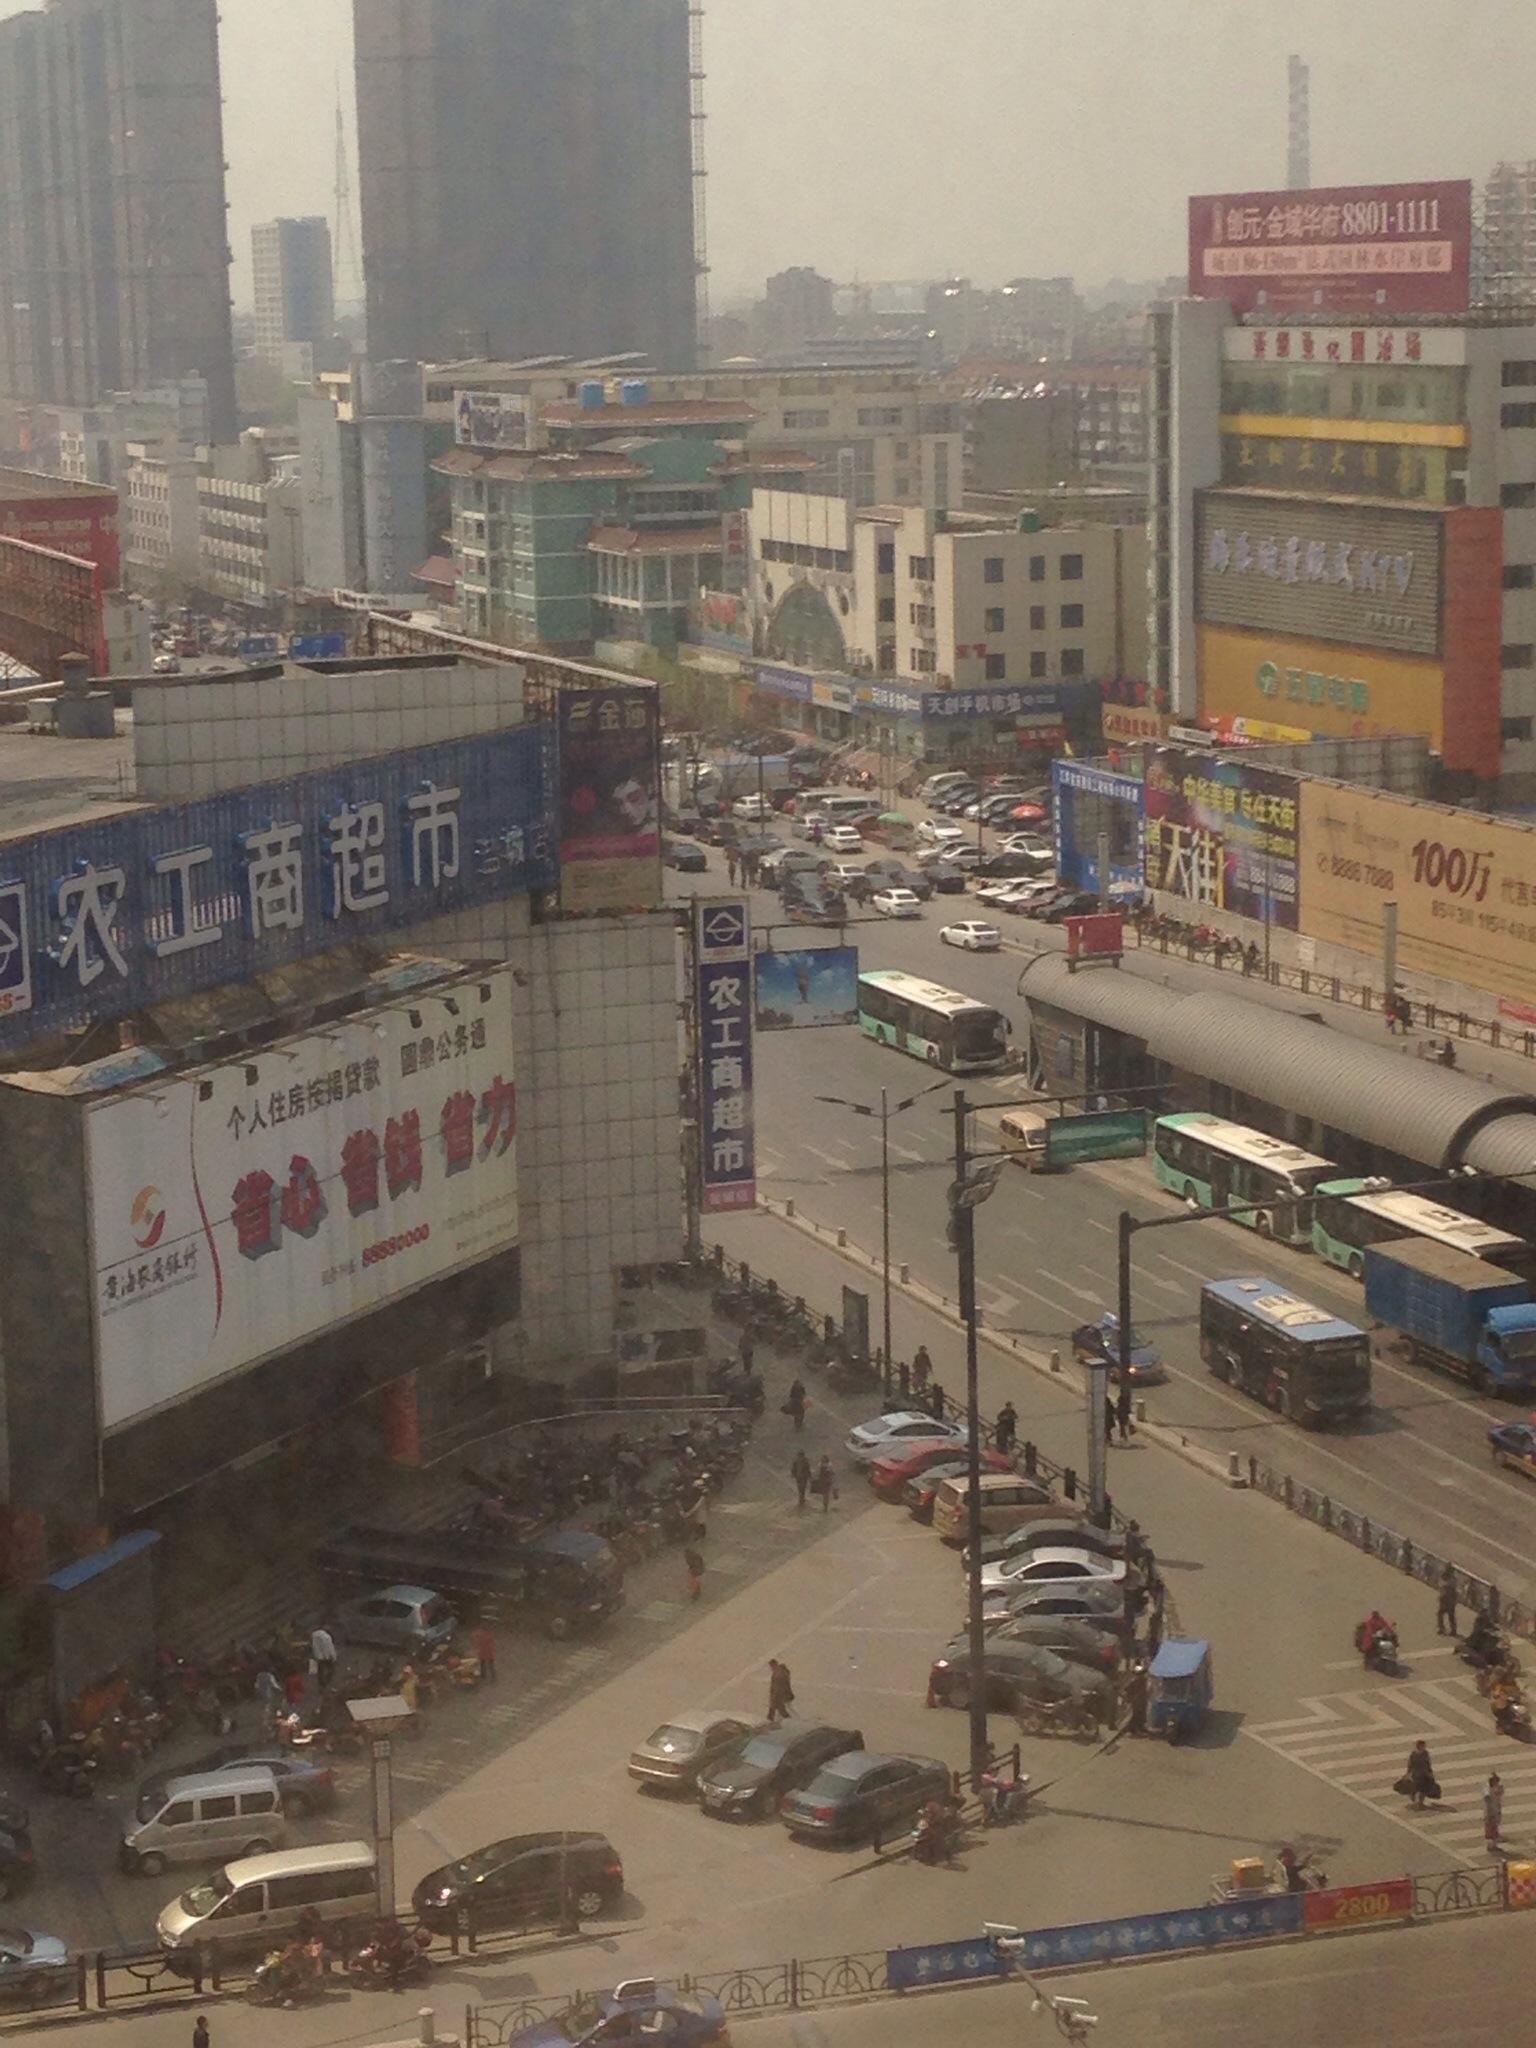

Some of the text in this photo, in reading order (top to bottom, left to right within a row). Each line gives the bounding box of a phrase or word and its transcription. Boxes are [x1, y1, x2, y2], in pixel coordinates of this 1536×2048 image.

[57, 779, 462, 986] 农工商超市
[1411, 838, 1495, 902] 100万
[227, 1055, 382, 1140] 个人住房按揭贷款
[708, 975, 745, 1173] 农工商超市
[441, 1074, 516, 1178] 省力
[1334, 1893, 1390, 1921] 2800
